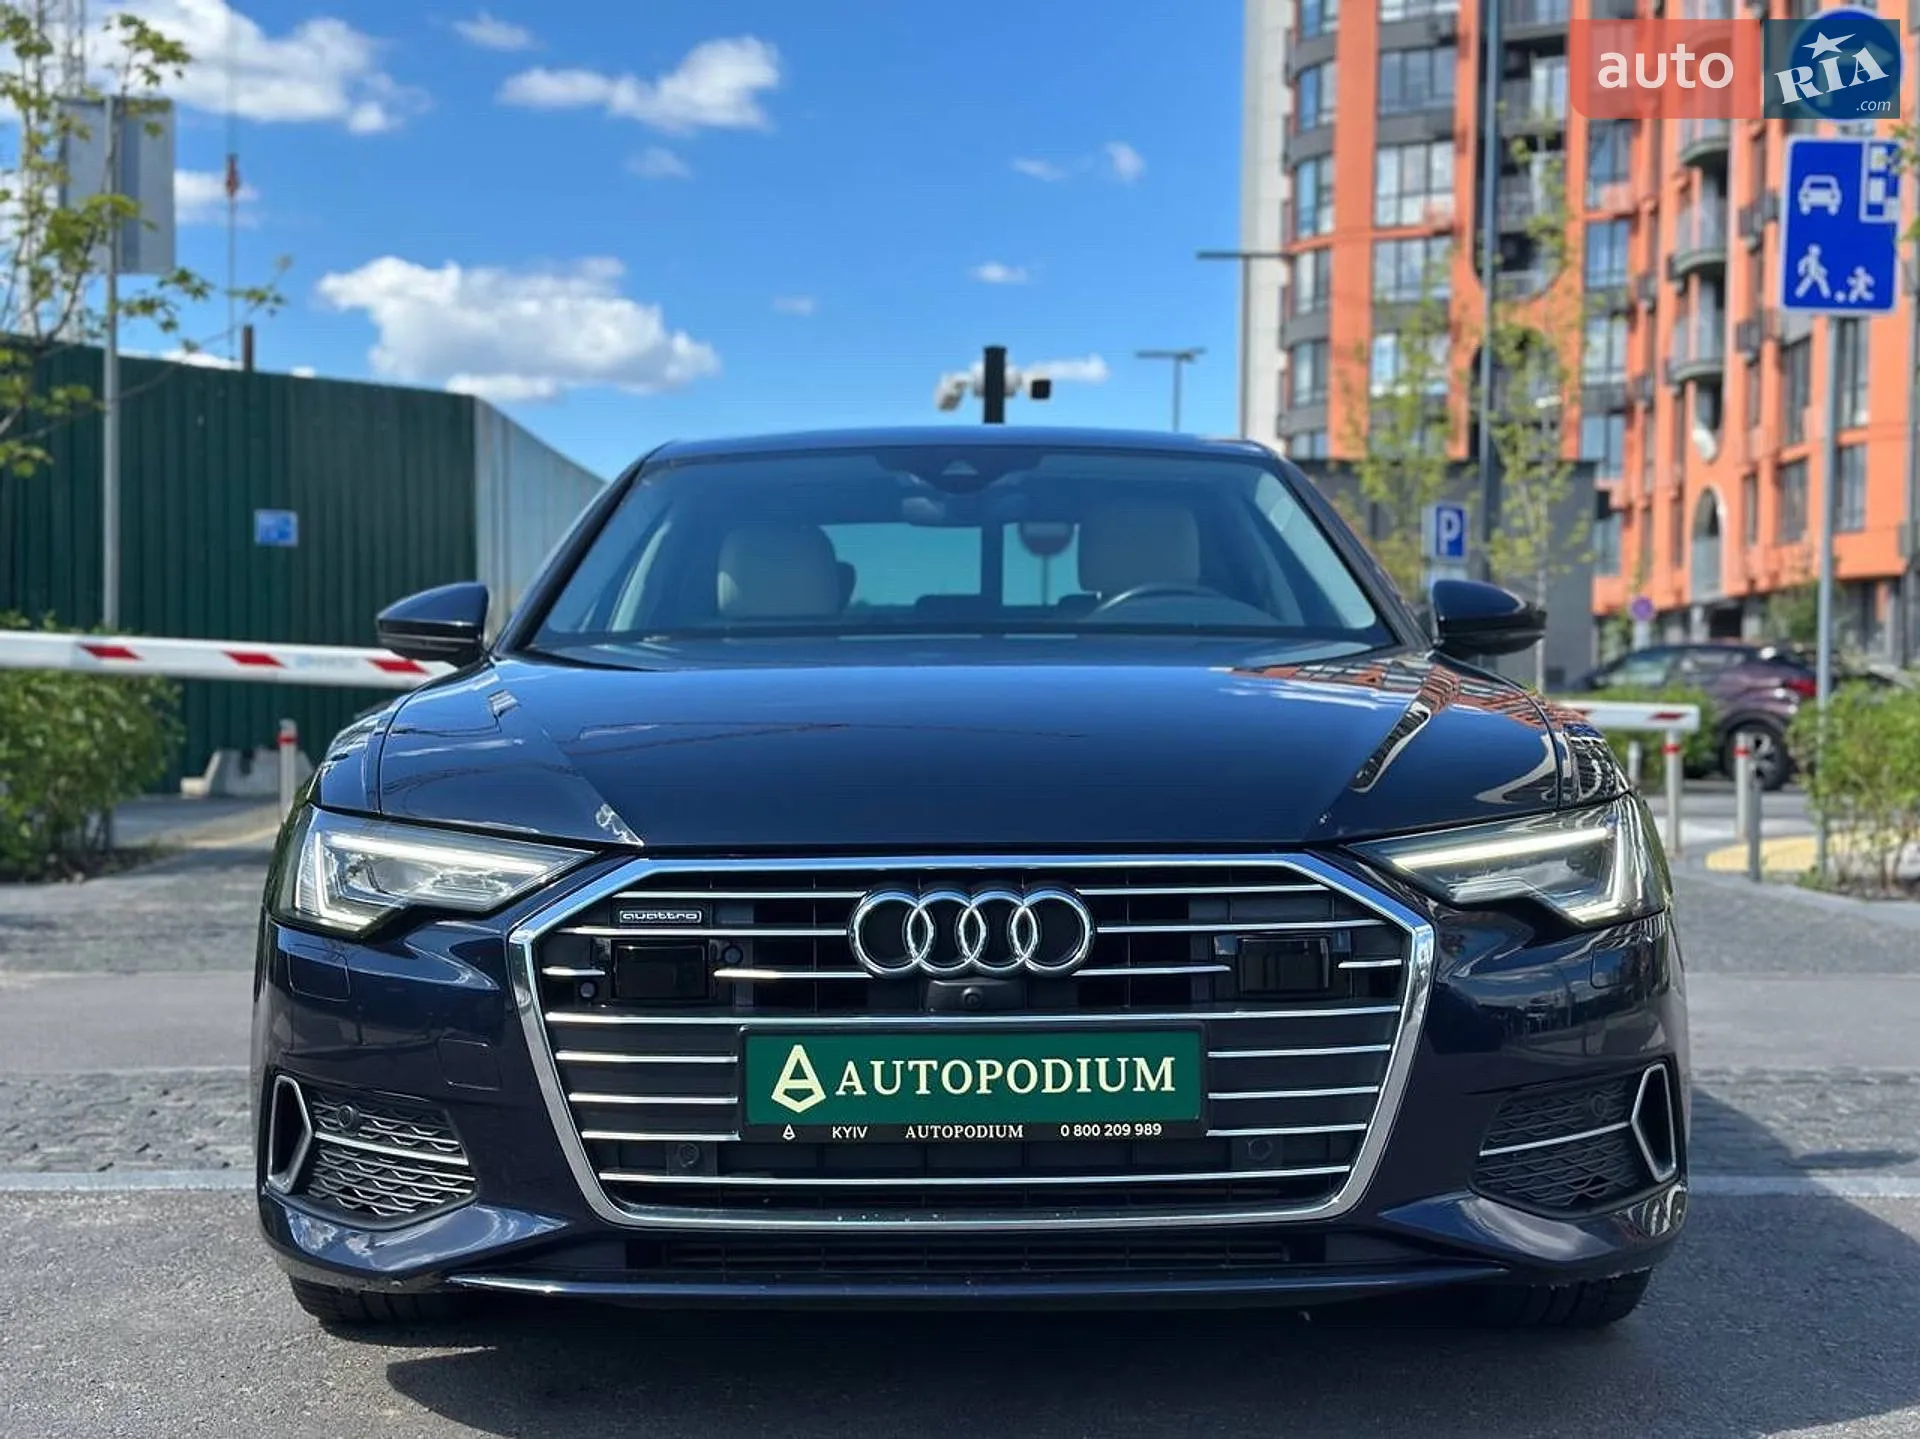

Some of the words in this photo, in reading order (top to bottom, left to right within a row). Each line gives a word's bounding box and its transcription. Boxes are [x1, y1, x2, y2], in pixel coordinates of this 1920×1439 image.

[1439, 509, 1461, 554] P
[622, 911, 698, 921] quattro
[835, 1056, 1176, 1097] AUTOPODIUM
[832, 1126, 868, 1139] KYIV
[905, 1125, 1024, 1139] AUTOPODIUM
[1060, 1125, 1070, 1137] 0
[1073, 1124, 1101, 1137] 800
[1104, 1124, 1131, 1137] 209
[1134, 1123, 1162, 1136] 989
